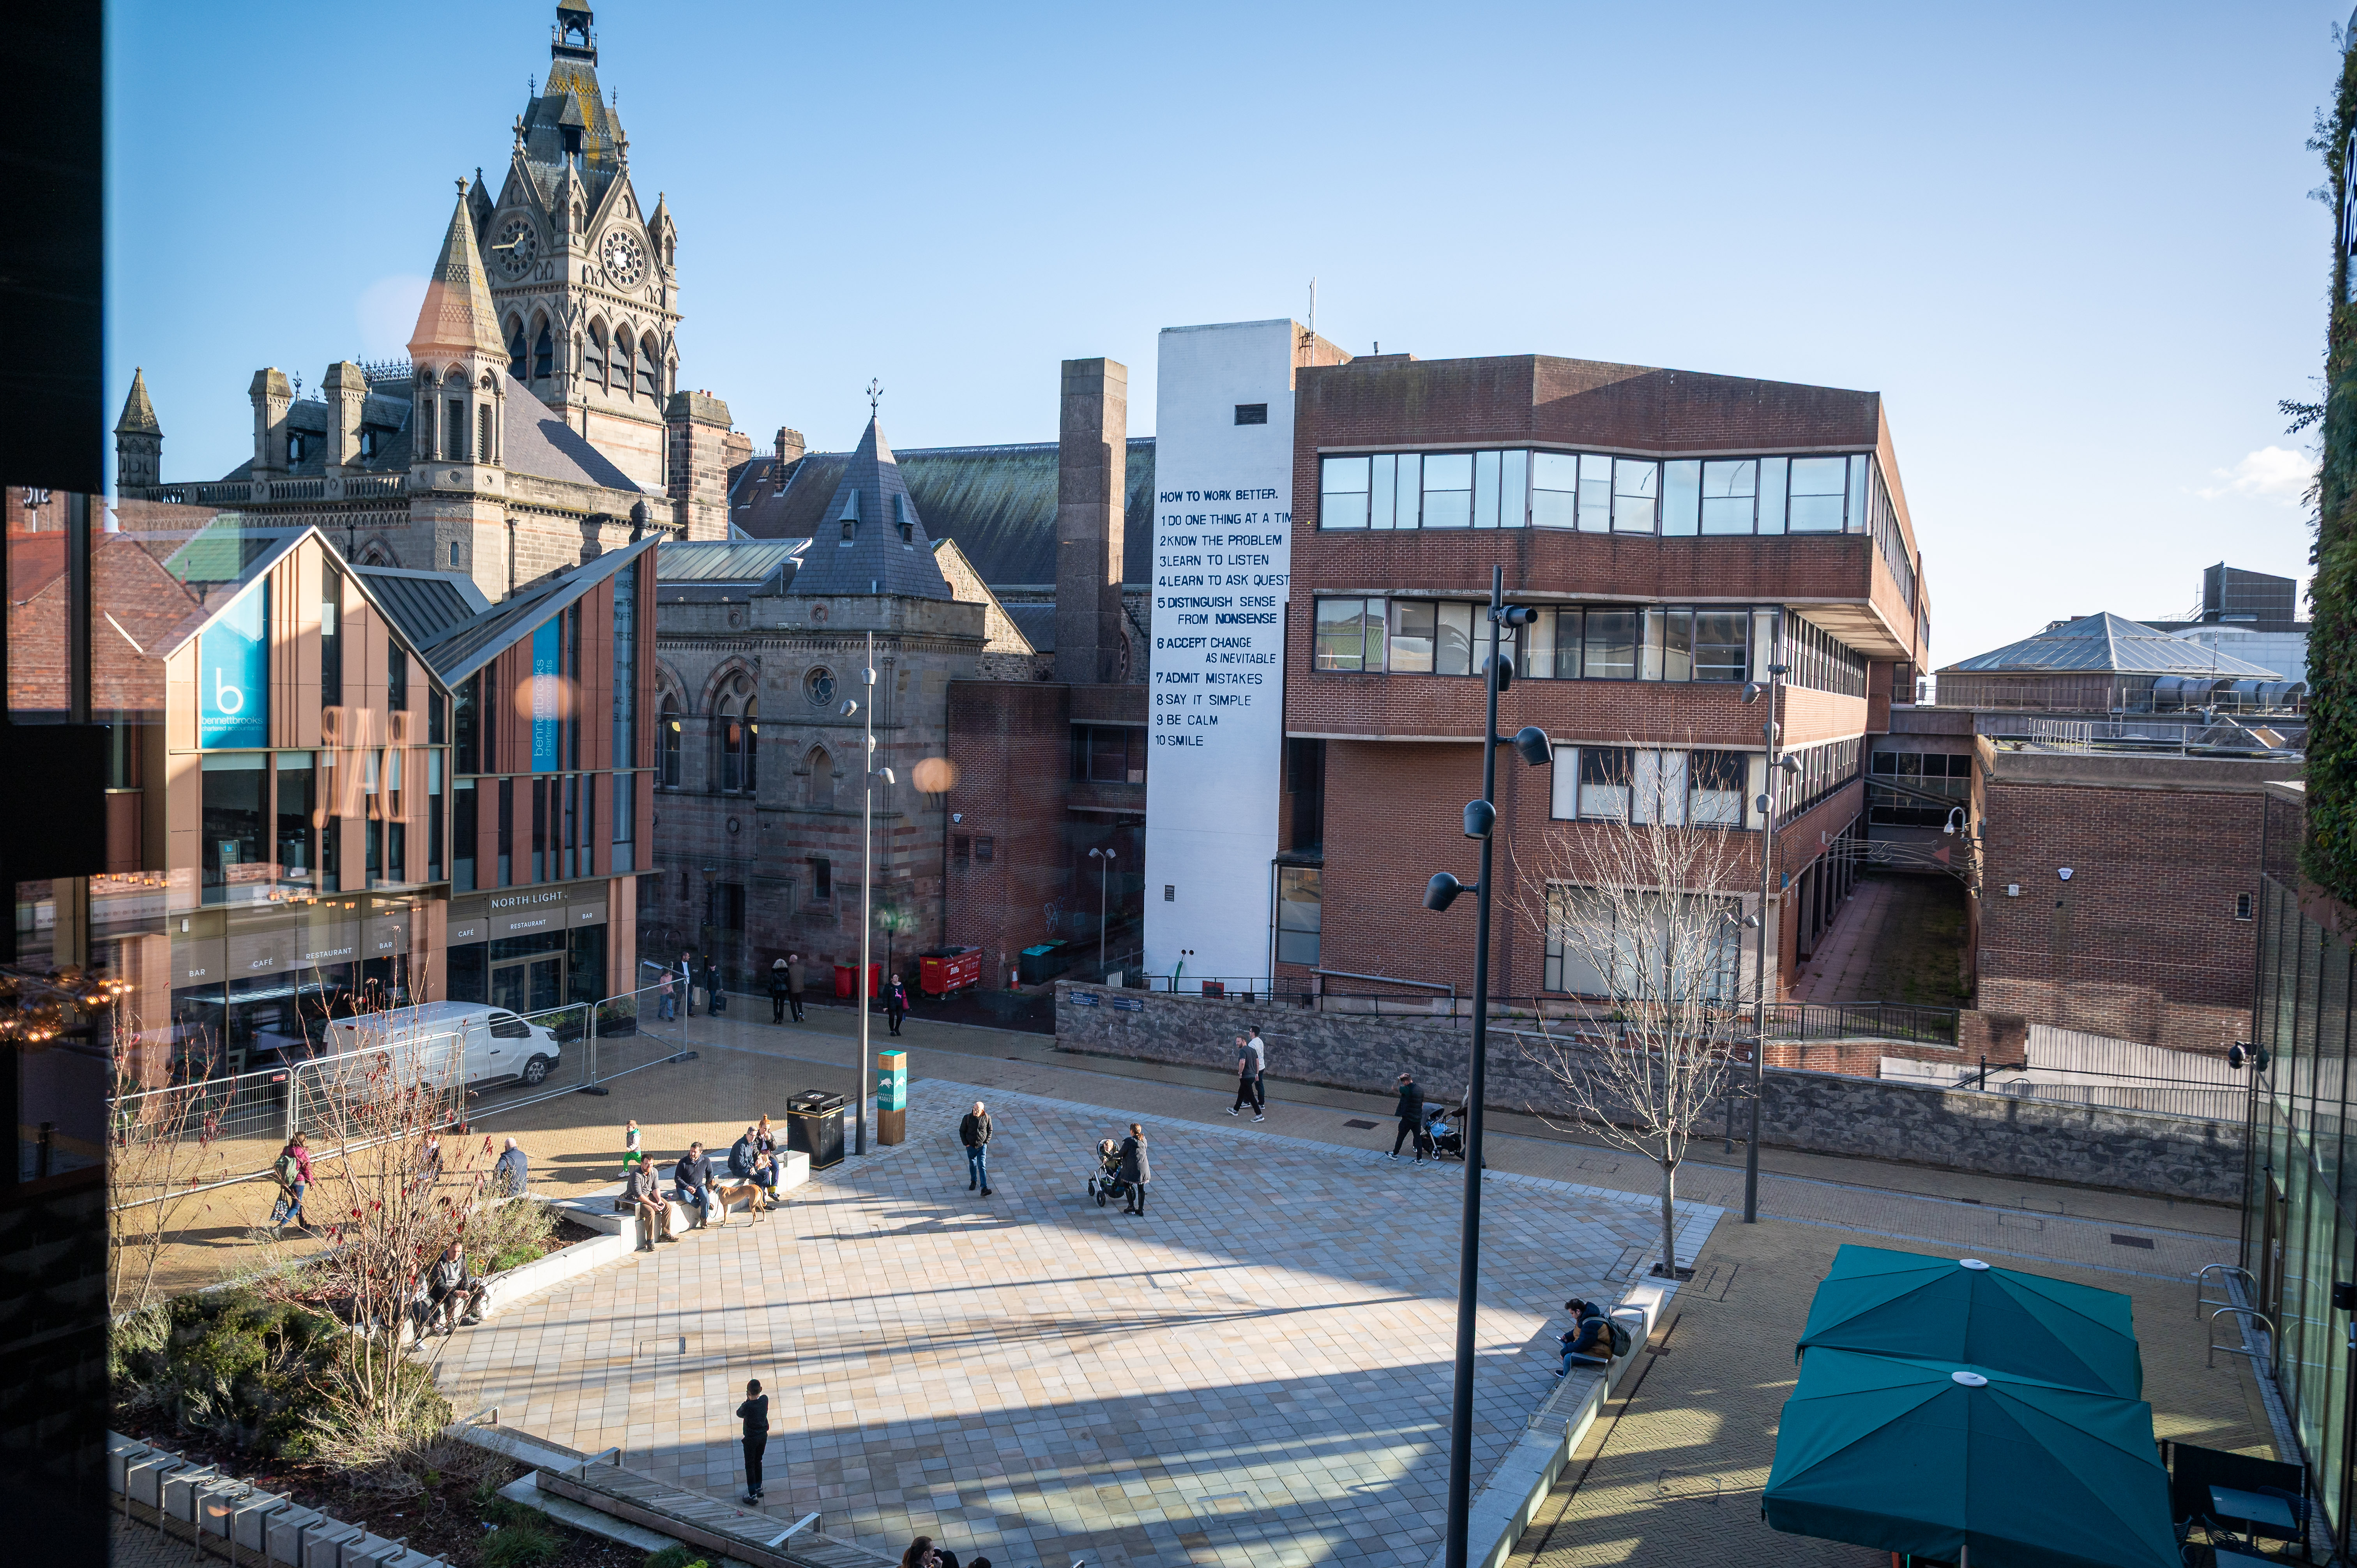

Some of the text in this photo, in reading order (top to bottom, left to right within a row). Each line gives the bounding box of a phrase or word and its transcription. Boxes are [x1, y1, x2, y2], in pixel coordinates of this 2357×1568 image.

[1160, 489, 1278, 503] HOW TO WORK BETTER.
[1169, 515, 1181, 526] DO
[1186, 515, 1206, 525] ONE
[1210, 514, 1241, 524] THING
[1245, 513, 1257, 523] AT
[1263, 513, 1269, 523] A
[1168, 536, 1197, 546] KNOW
[1202, 535, 1223, 545] THE
[1228, 535, 1281, 545] PROBLEM
[1168, 555, 1201, 567] LEARN
[1207, 554, 1222, 565] TO
[1228, 554, 1269, 565] LISTEN
[1168, 575, 1203, 586] LEARN
[1208, 575, 1221, 585] TO
[1226, 574, 1248, 585] ASK
[1254, 574, 1290, 586] QUEST
[1169, 597, 1232, 608] DISTINGUISH
[1240, 596, 1276, 607] SENSE
[1178, 613, 1277, 624] FROM NONSENSE
[1166, 637, 1207, 648] ACCEPT
[1210, 637, 1251, 648] CHANGE
[1205, 653, 1276, 663] AS INEVITABLE
[1166, 672, 1200, 683] ADMIT
[1206, 673, 1262, 684] MISTAKES
[216, 667, 244, 714] b
[1166, 694, 1186, 705] SAY
[1193, 694, 1202, 705] IT
[1209, 694, 1251, 706] SIMPLE
[534, 659, 544, 756] bennettbrooks
[202, 715, 263, 725] bennettbrooks
[1167, 715, 1181, 725] BE
[1188, 715, 1218, 725] CALM
[1168, 735, 1203, 746] SMILE
[491, 892, 562, 908] NORTH LIGHT
[511, 919, 546, 929] RESTAURANT
[458, 928, 474, 937] CAFÉ
[306, 947, 352, 960] RESTAURANT
[253, 957, 273, 967] CAFÉ
[189, 969, 205, 977] BAR
